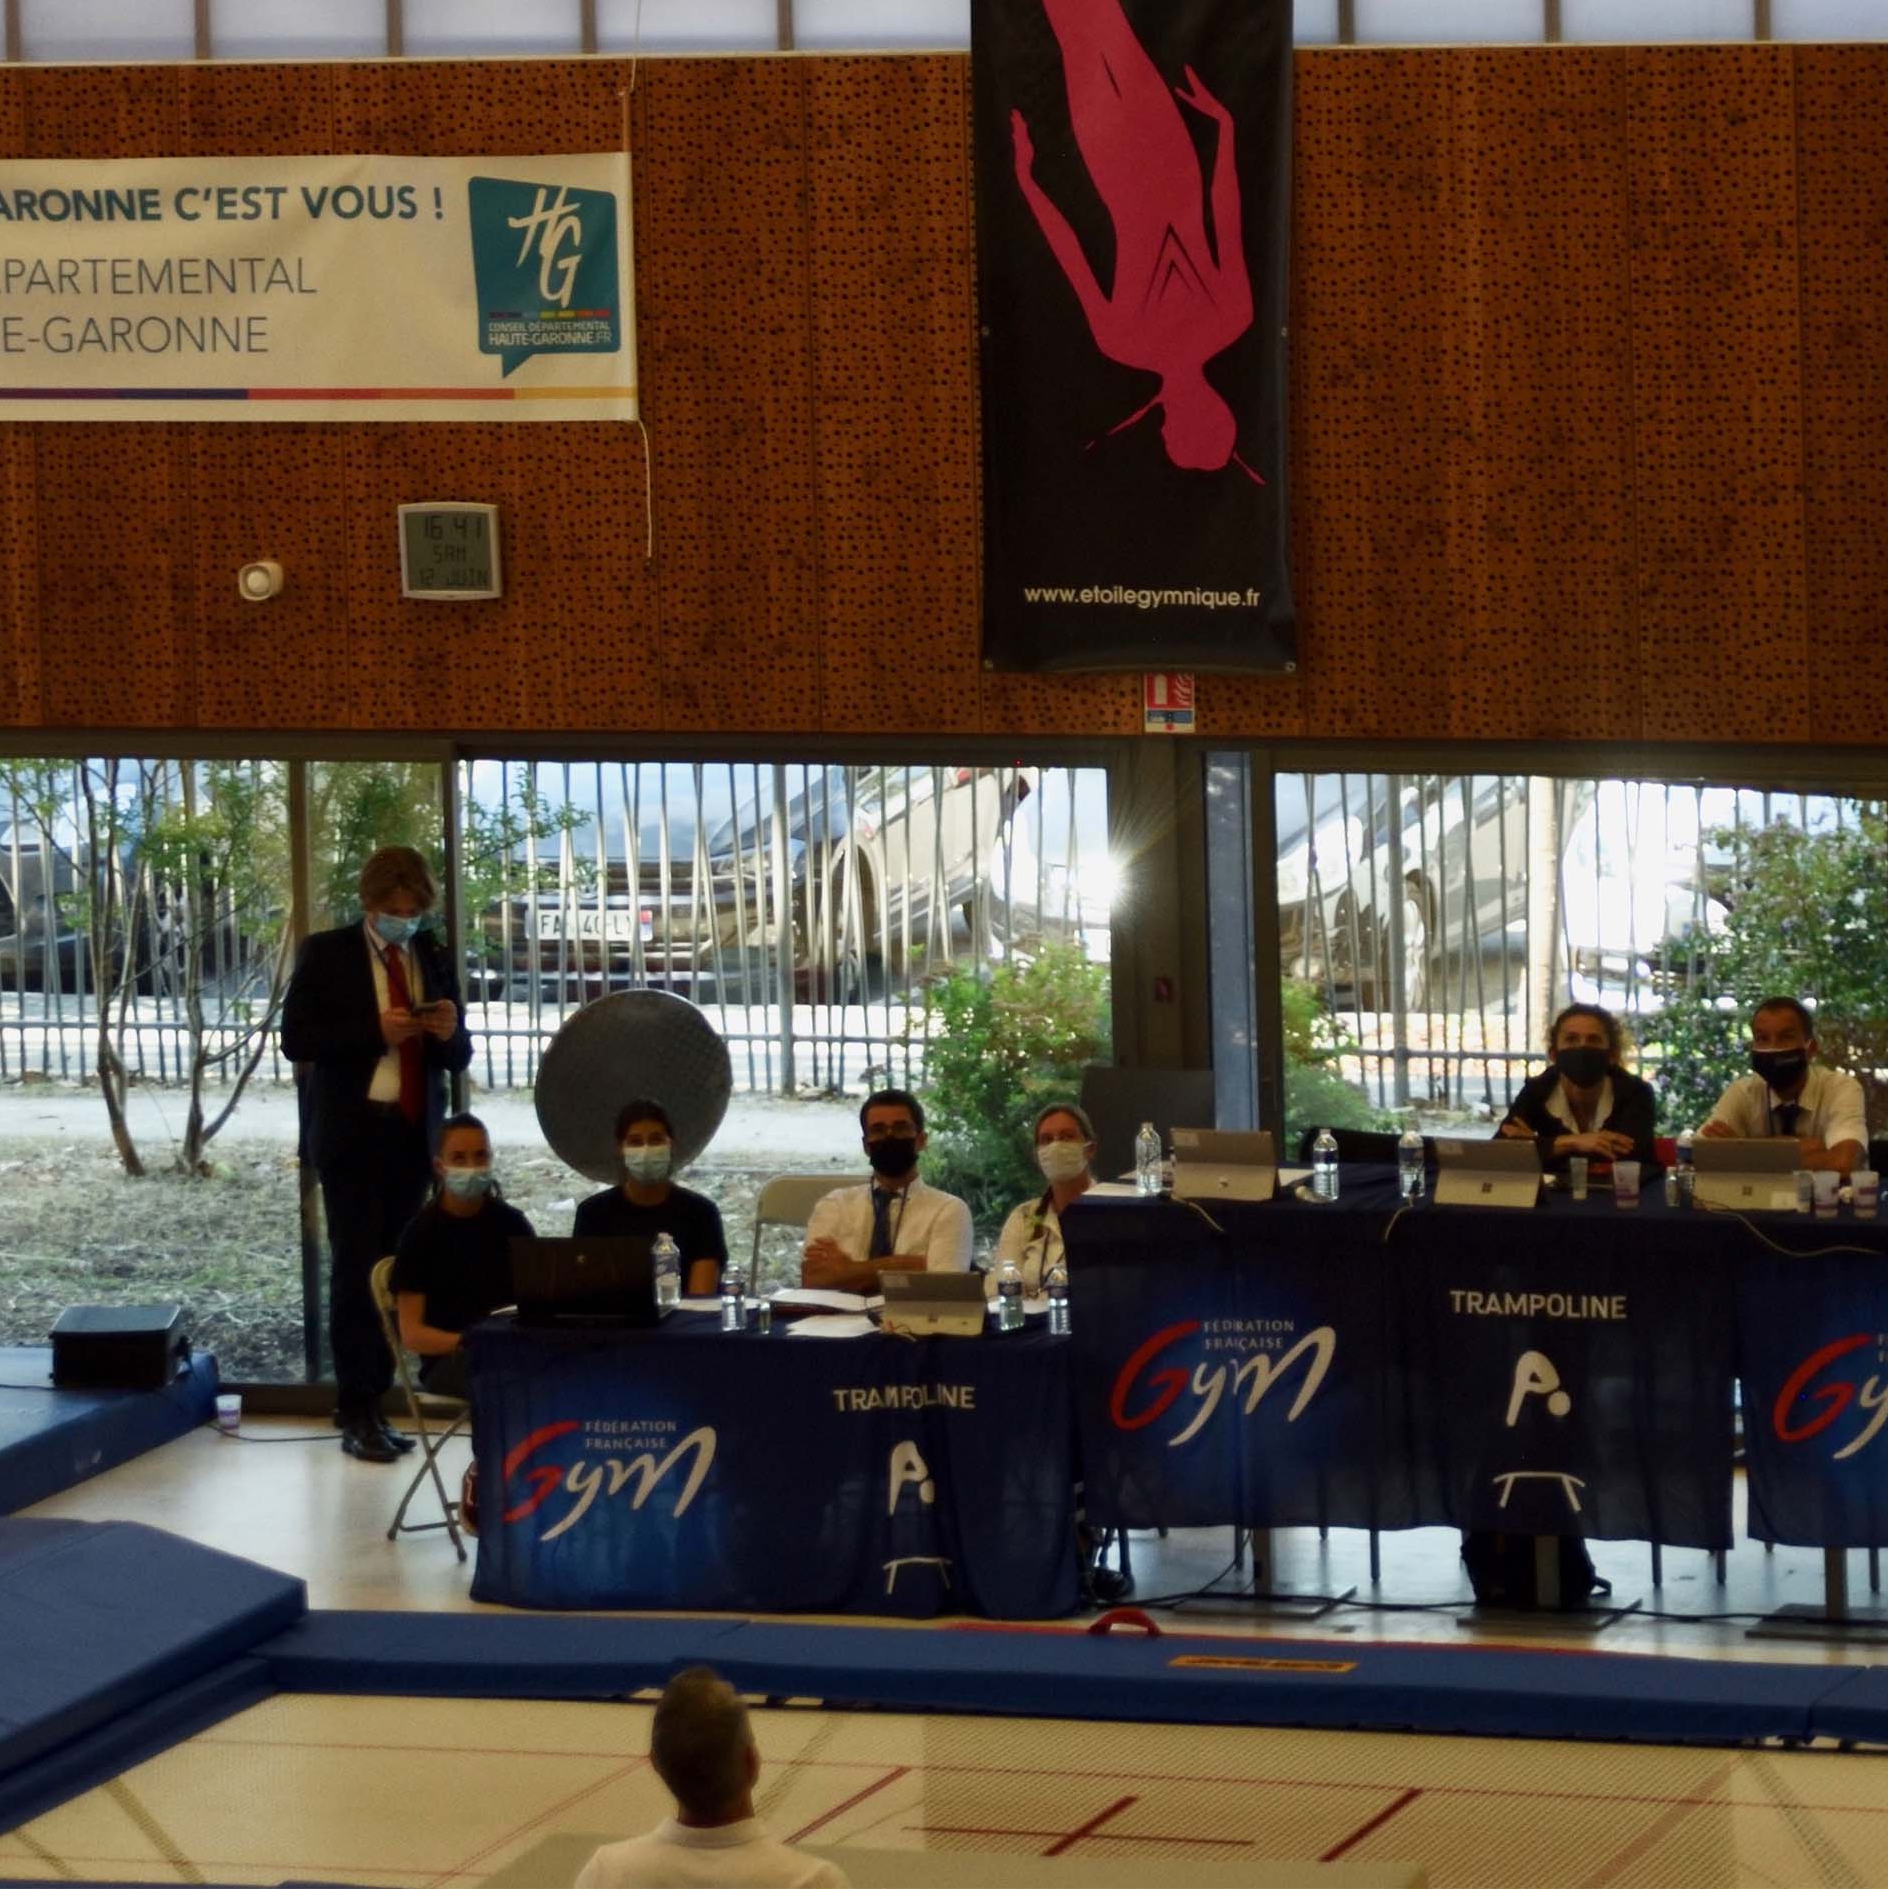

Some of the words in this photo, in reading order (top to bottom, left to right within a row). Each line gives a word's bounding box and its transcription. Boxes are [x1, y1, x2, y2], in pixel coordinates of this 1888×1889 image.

[174, 186, 288, 221] C'EST
[301, 185, 419, 220] VOUS
[433, 186, 444, 220] !
[489, 321, 527, 333] CONSEIL
[529, 319, 610, 332] DÉPARTEMENTAL
[1023, 584, 1261, 610] www.etoilegymnique.fr
[1448, 1289, 1628, 1321] TRAMPOLINE
[832, 1384, 976, 1413] TRAMPOLINE
[584, 1419, 678, 1434] FÉDÉRATION
[584, 1436, 667, 1453] FRANÇAISE
